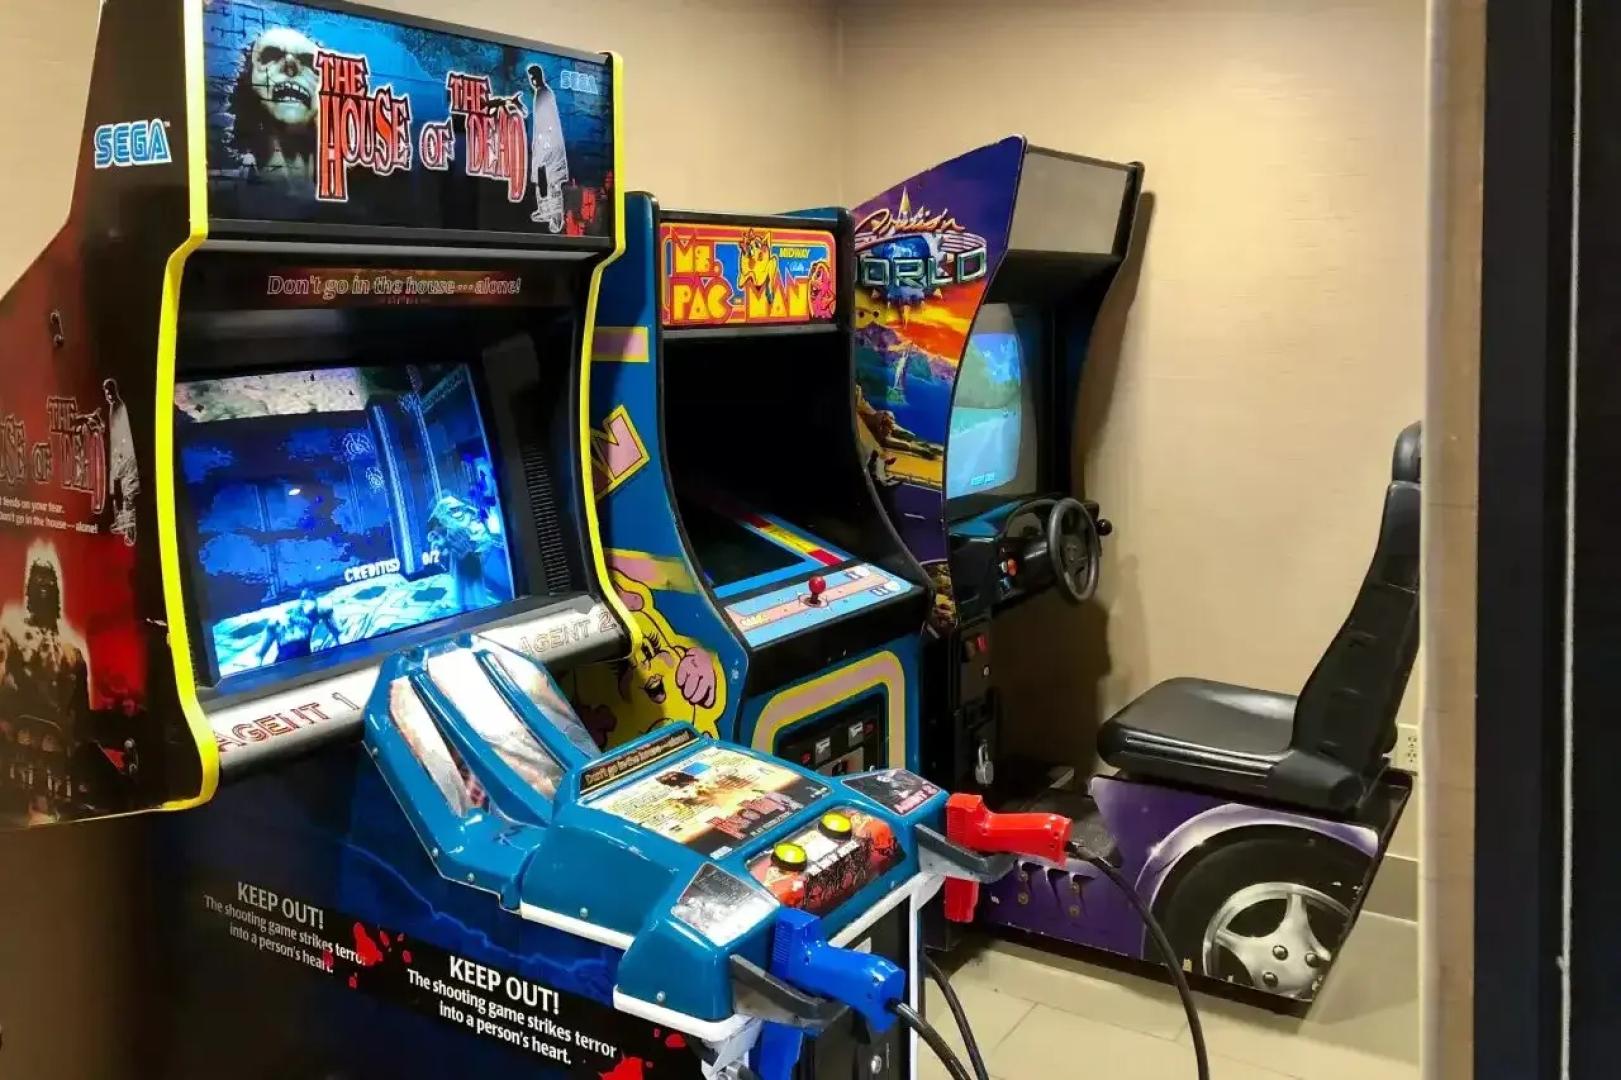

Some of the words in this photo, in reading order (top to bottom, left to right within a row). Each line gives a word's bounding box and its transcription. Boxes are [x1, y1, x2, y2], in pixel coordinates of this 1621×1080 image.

[315, 50, 369, 97] THE
[447, 71, 491, 115] THE
[560, 70, 598, 95] SEGA
[94, 118, 172, 169] SEGA
[316, 86, 413, 201] HOUSE
[420, 121, 455, 171] OF
[466, 104, 528, 202] DEAD
[674, 240, 721, 274] MS.
[779, 247, 811, 258] MIDWAY
[855, 246, 987, 287] ORLD
[267, 275, 321, 295] Don't
[322, 278, 349, 300] go
[351, 275, 371, 295] in
[374, 276, 402, 295] the
[673, 281, 809, 320] PAC-MAN
[203, 894, 224, 913] The
[224, 903, 267, 933] shooting
[268, 920, 298, 940] game
[299, 931, 334, 954] strikes
[237, 881, 279, 913] KEEP
[281, 898, 324, 931] OUT!
[229, 921, 250, 942] into
[251, 932, 258, 945] a
[259, 938, 301, 962] person's
[450, 955, 501, 993] KEEP
[505, 976, 560, 1015] OUT!
[407, 968, 431, 990] The
[433, 979, 486, 1015] shooting
[488, 1001, 525, 1026] game
[527, 1014, 572, 1043] strikes
[574, 1031, 618, 1059] terror
[439, 1000, 464, 1024] into
[466, 1013, 475, 1028] a
[476, 1018, 530, 1049] person's
[532, 1036, 572, 1065] heart.
